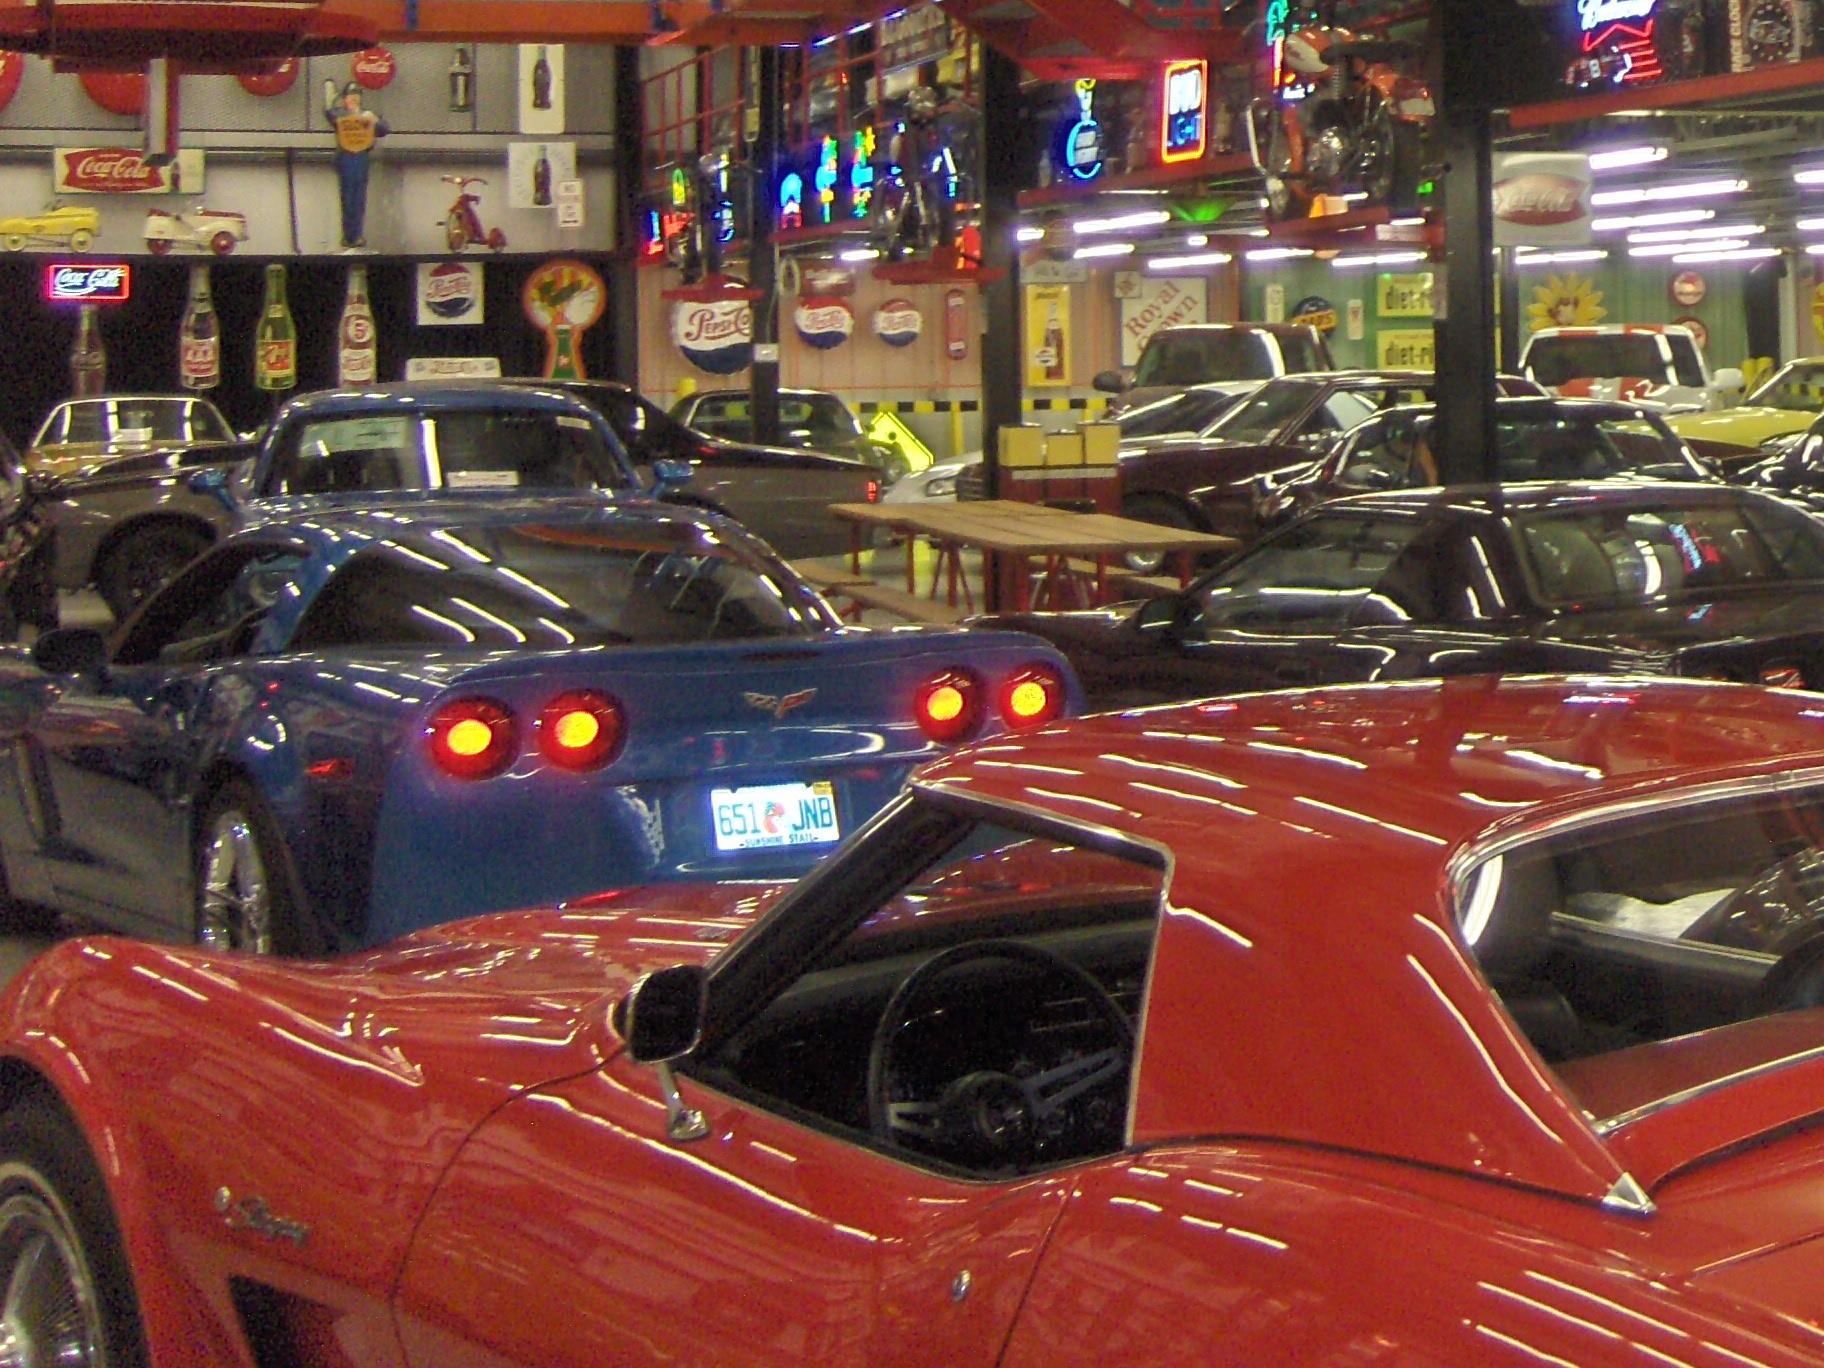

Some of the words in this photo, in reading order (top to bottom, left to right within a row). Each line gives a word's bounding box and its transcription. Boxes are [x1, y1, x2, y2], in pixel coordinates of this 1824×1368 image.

[1125, 280, 1181, 336] Royal
[718, 802, 762, 837] 651
[791, 796, 834, 832] JNB
